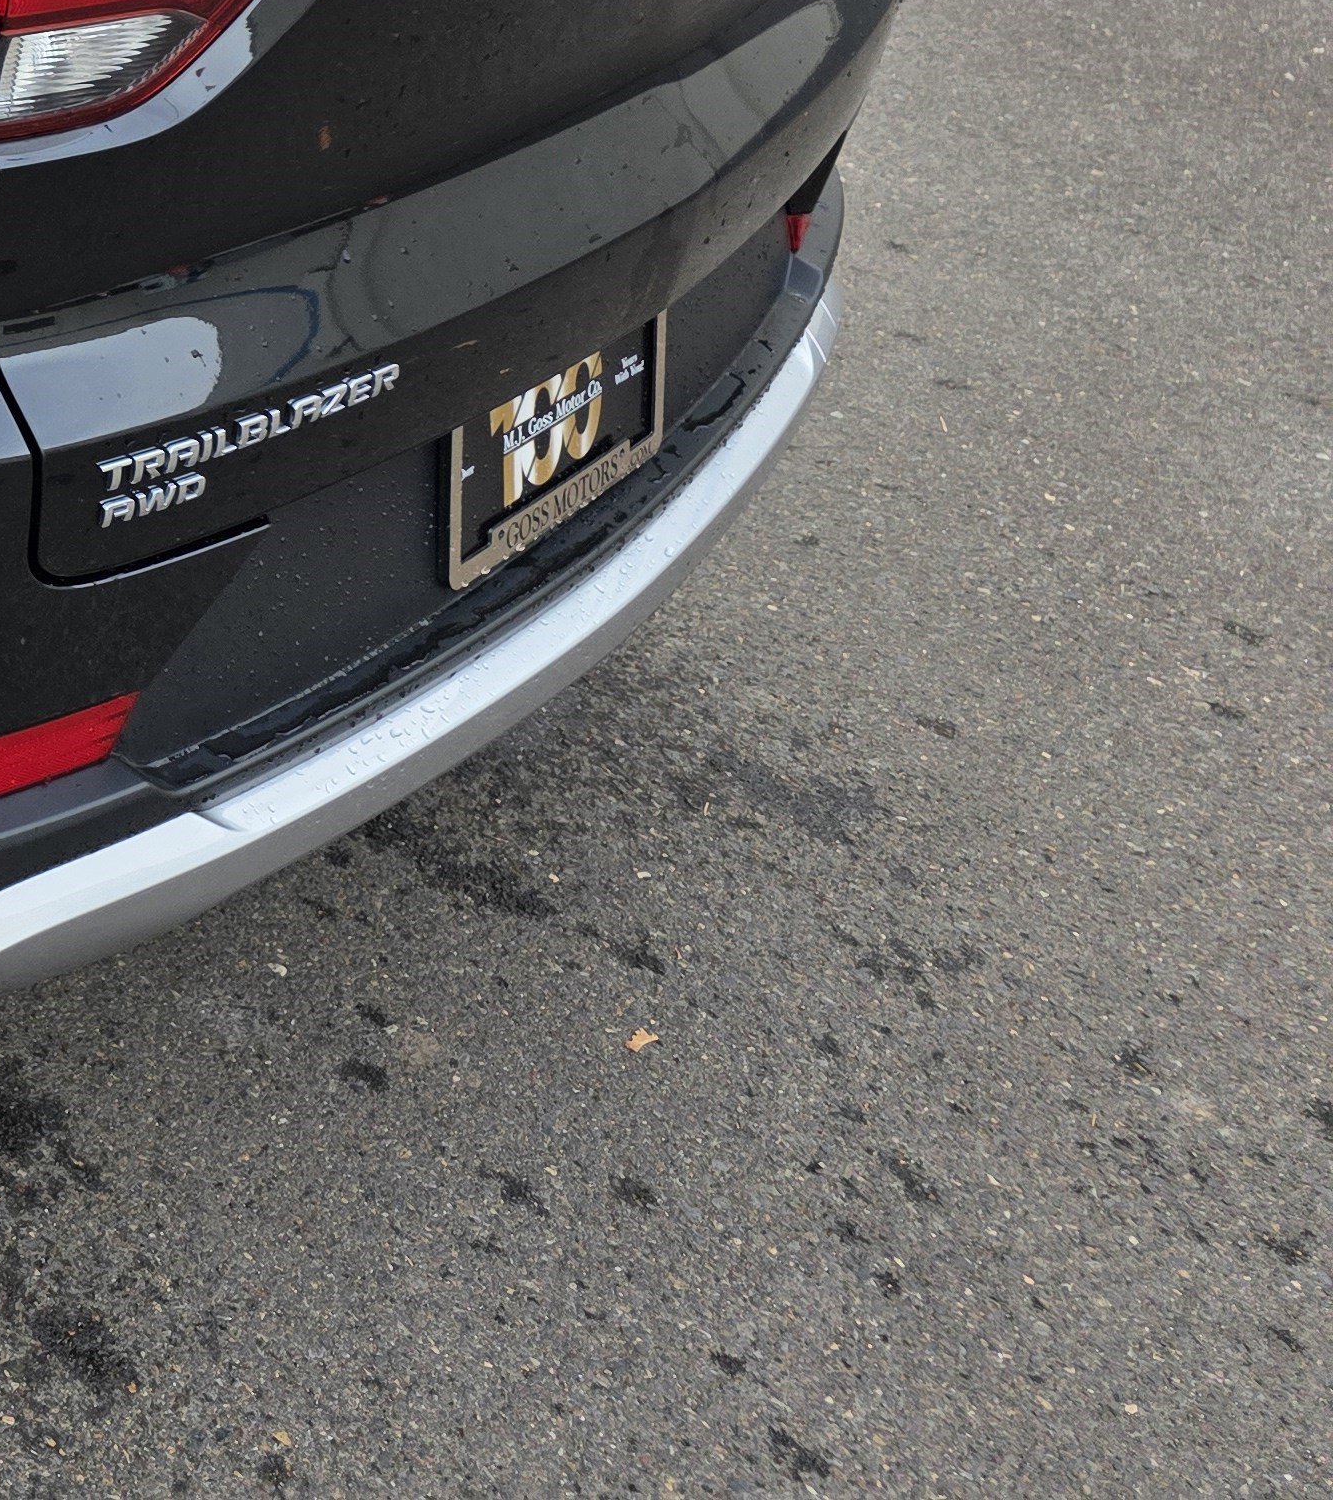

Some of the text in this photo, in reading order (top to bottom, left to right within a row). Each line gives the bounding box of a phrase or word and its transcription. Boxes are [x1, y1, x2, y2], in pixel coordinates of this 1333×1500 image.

[97, 363, 400, 491] TRAILBLAZER
[503, 380, 603, 451] M.J. Goss Motor Co.
[99, 471, 207, 528] AWD
[506, 501, 550, 549] GOSS
[553, 453, 618, 520] MOTORS
